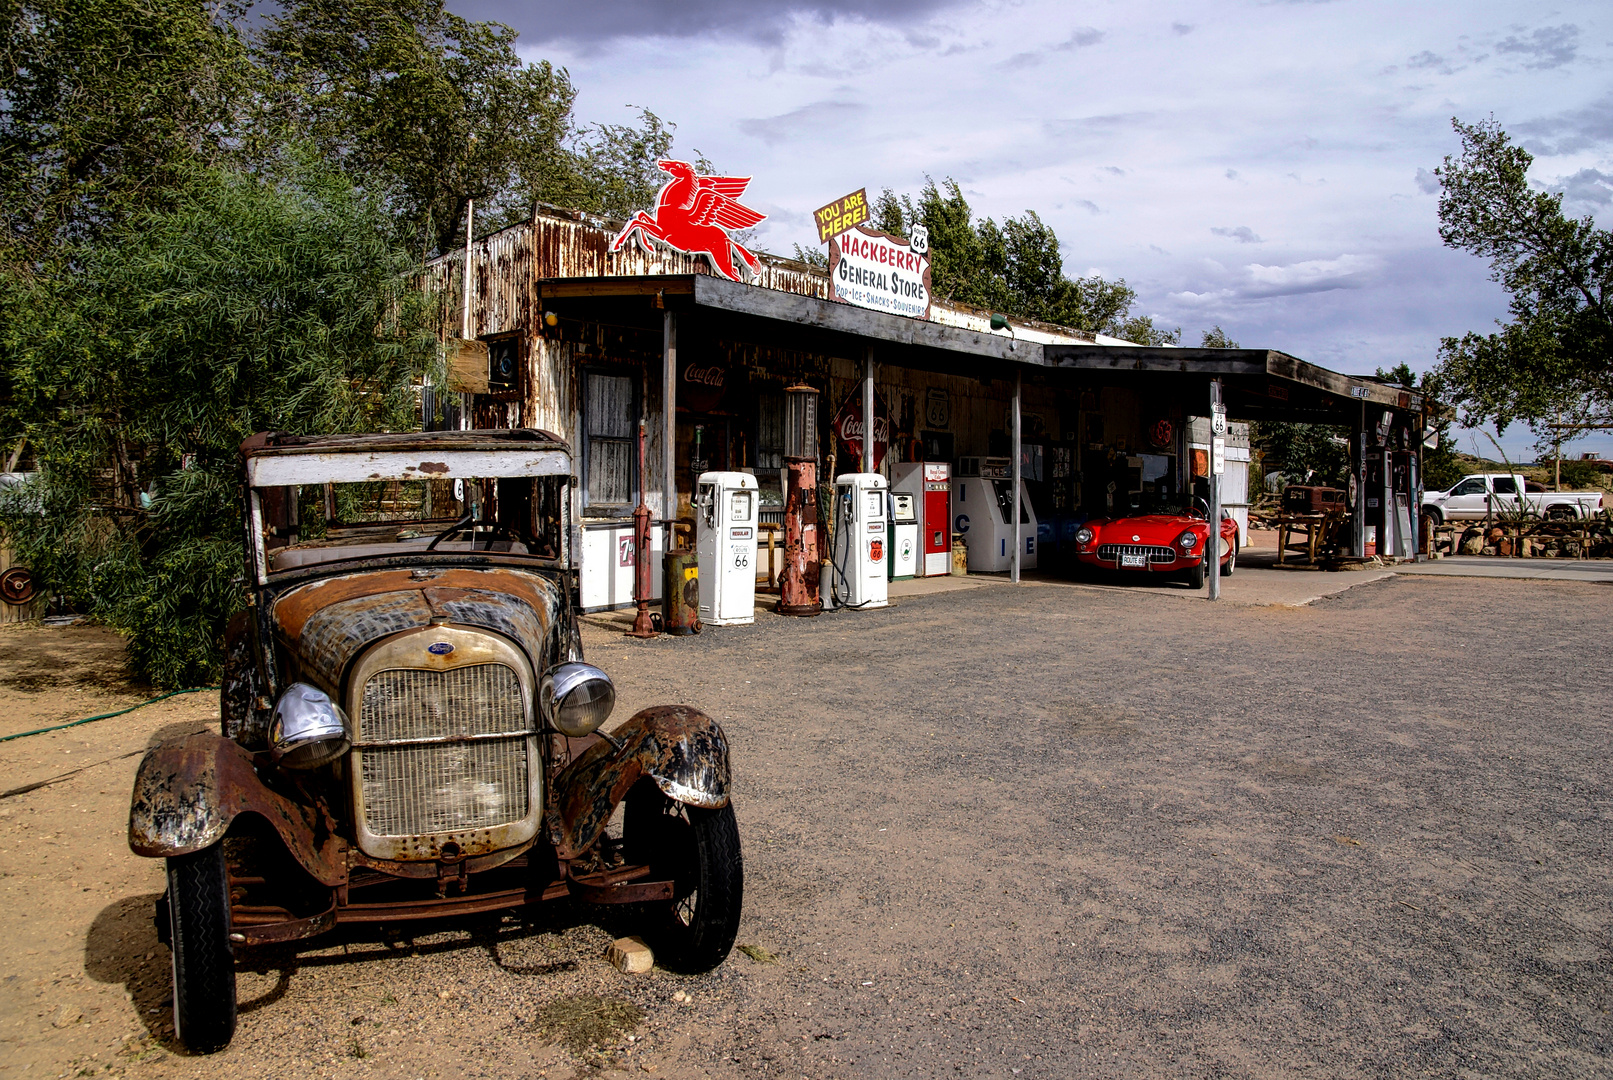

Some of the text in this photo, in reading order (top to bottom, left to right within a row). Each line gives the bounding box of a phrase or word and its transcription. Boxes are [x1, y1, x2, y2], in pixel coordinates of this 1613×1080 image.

[818, 192, 864, 224] YOU ARE
[821, 204, 867, 240] HERE!
[913, 227, 927, 237] ROUTE
[913, 236, 925, 249] 66
[841, 234, 922, 274] HACKBERRY
[839, 257, 924, 300] GENERAL STORE
[931, 407, 945, 421] 66
[1215, 420, 1223, 431] 66
[734, 554, 748, 568] 66
[872, 549, 881, 559] 66
